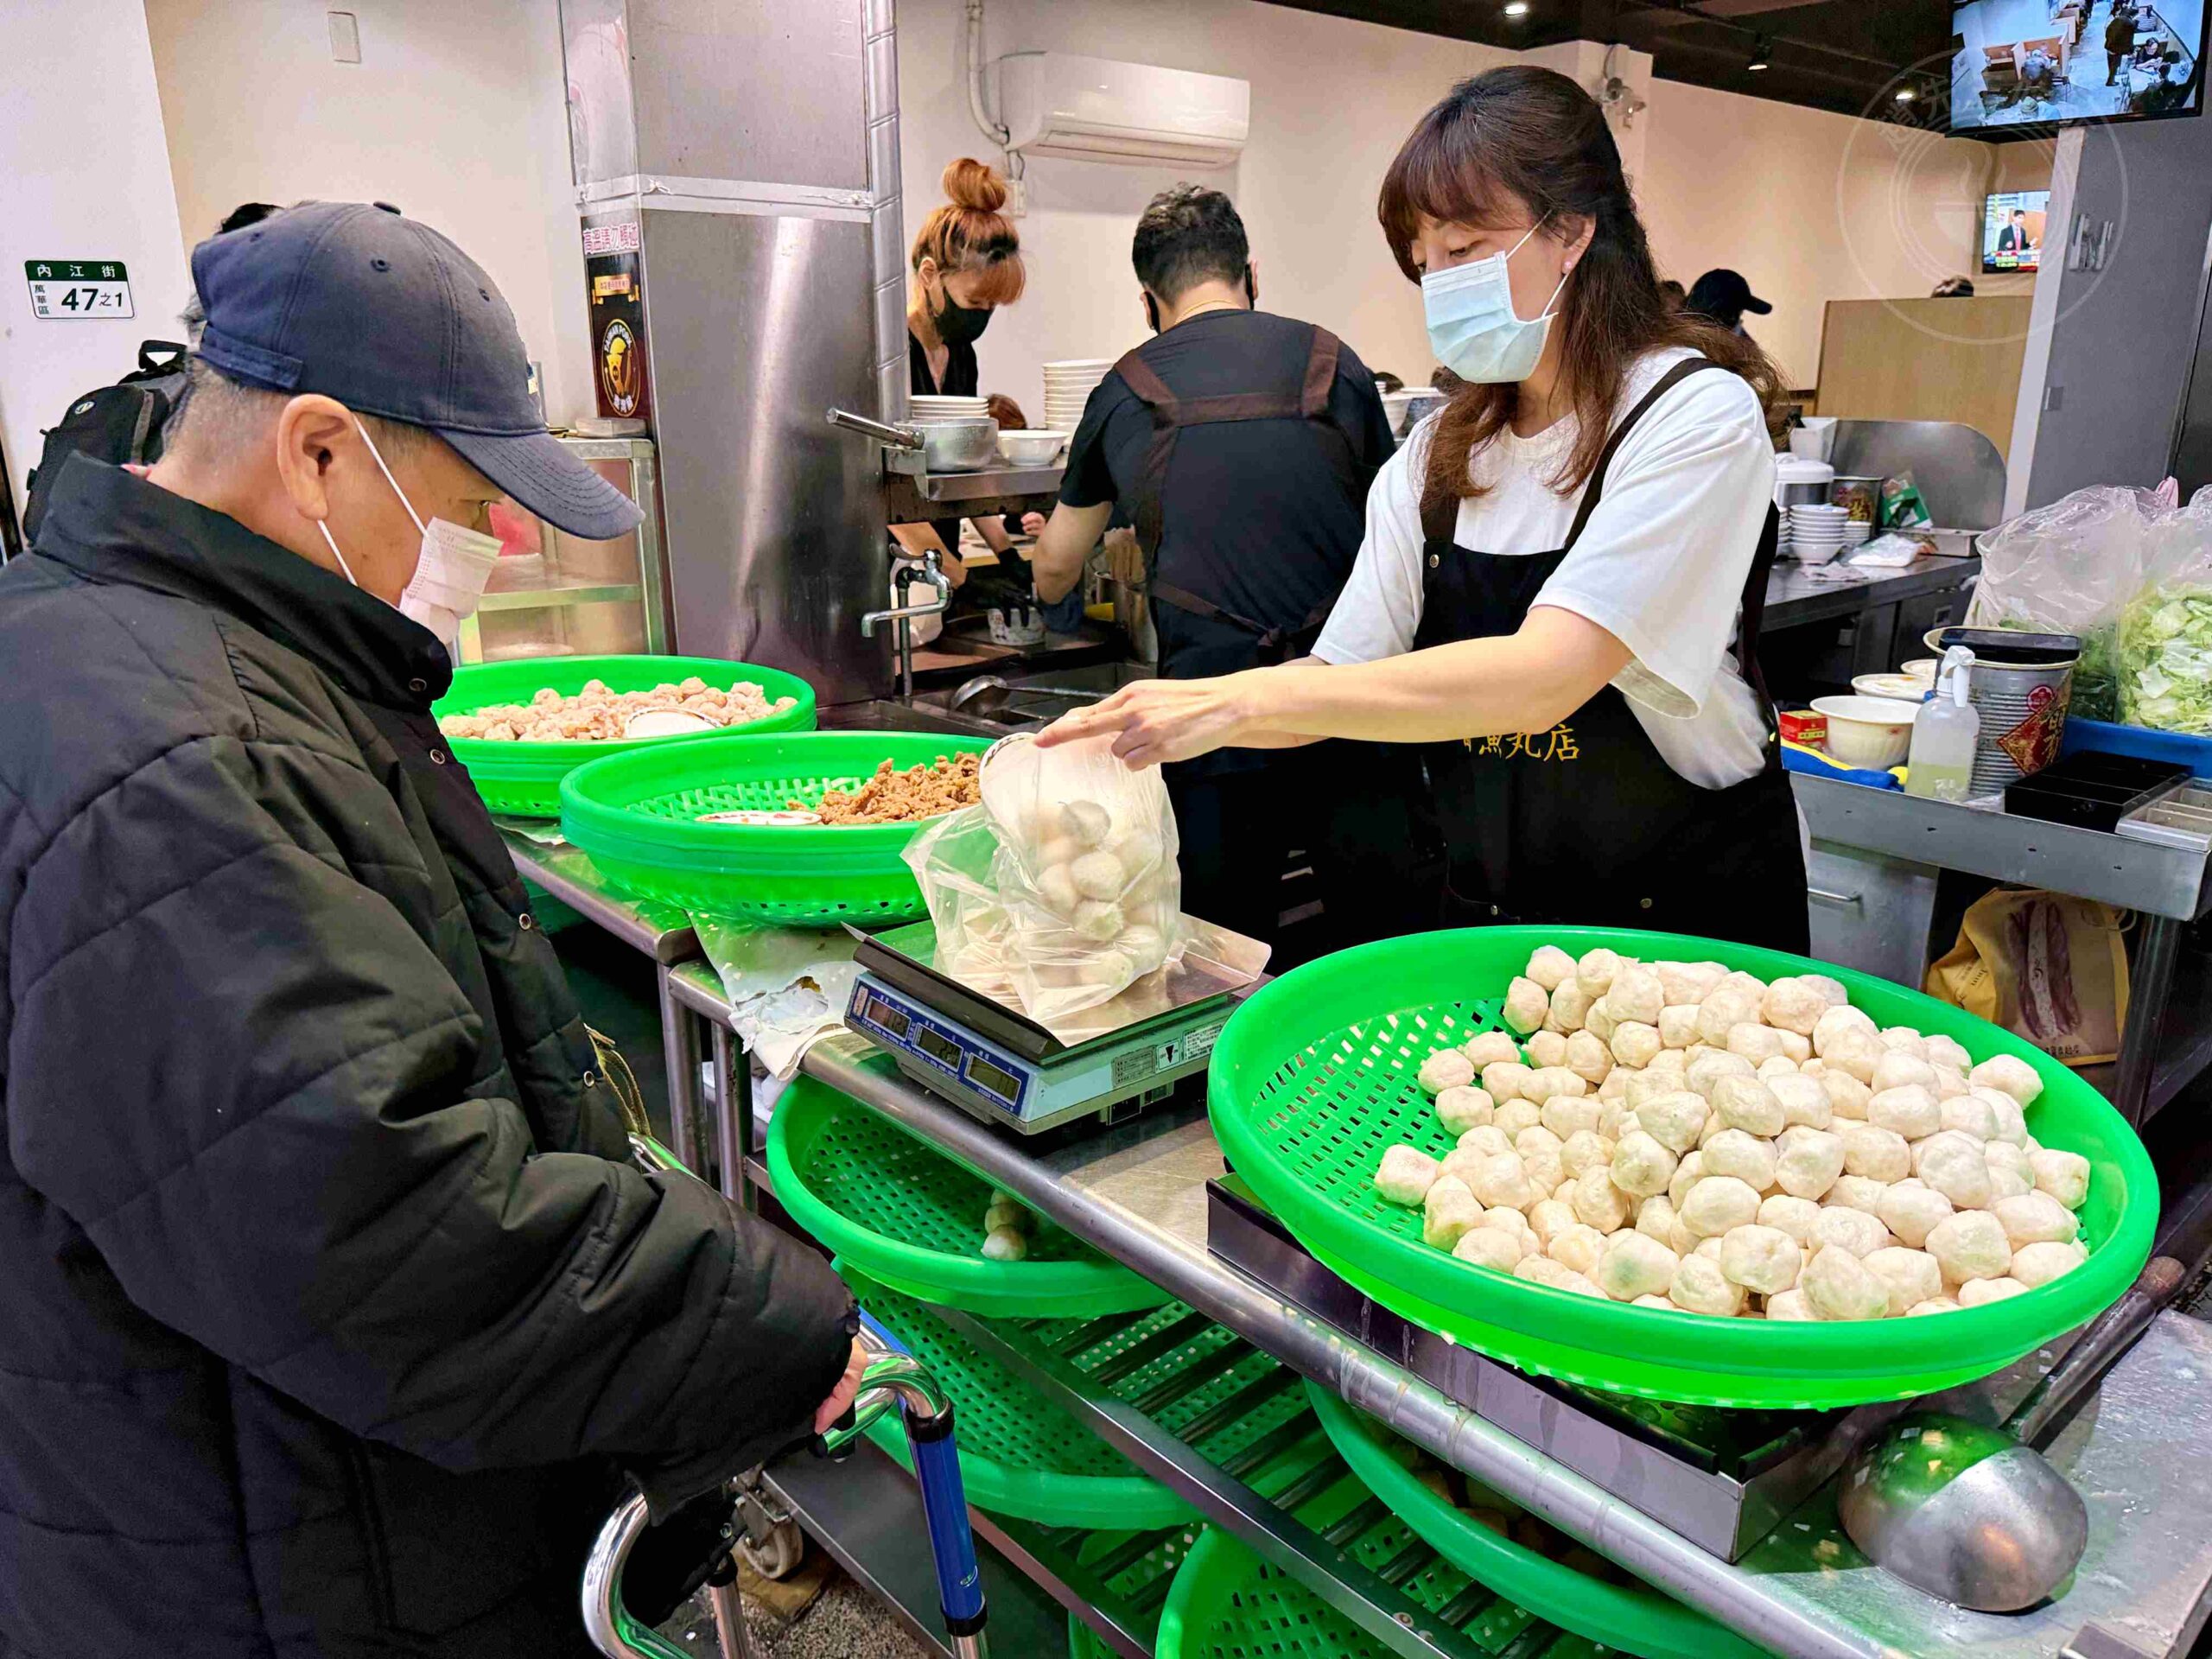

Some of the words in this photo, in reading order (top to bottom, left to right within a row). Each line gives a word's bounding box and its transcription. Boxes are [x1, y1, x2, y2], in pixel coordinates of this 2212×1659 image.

[37, 264, 116, 277] 內江街
[34, 284, 49, 315] 萬華區
